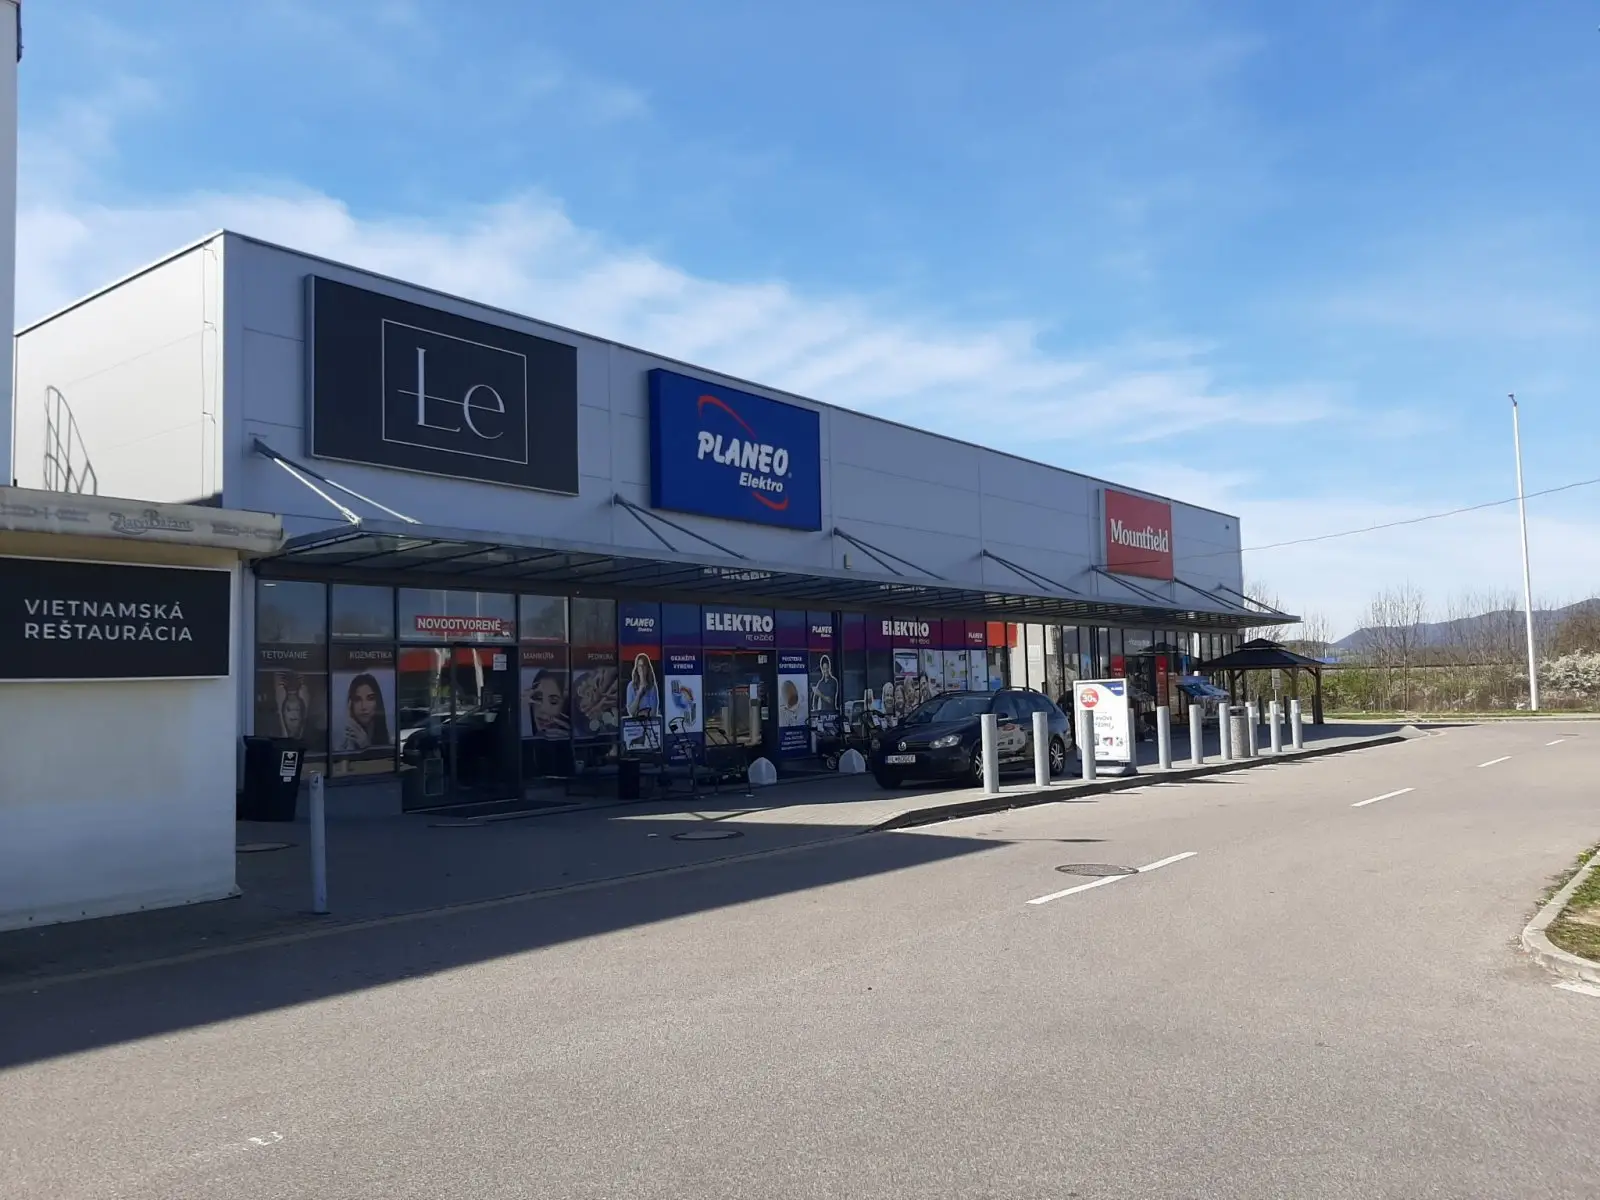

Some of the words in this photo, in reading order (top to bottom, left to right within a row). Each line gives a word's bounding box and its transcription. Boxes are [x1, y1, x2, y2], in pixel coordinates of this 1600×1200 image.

[398, 347, 505, 439] Le
[697, 431, 789, 476] PLANEO
[739, 472, 784, 493] Elektro
[1110, 518, 1170, 553] Mountfield
[24, 598, 184, 620] VIETNAMSKÁ
[24, 620, 193, 641] REŠTAURÁCIA
[417, 617, 502, 631] NOVOOTVORENÉ
[625, 617, 655, 628] PLANEO
[706, 612, 774, 633] ELEKTRO
[882, 620, 930, 637] ELEKTRO
[261, 650, 309, 660] TETOVANIE
[349, 650, 393, 660] KOZMETIKA
